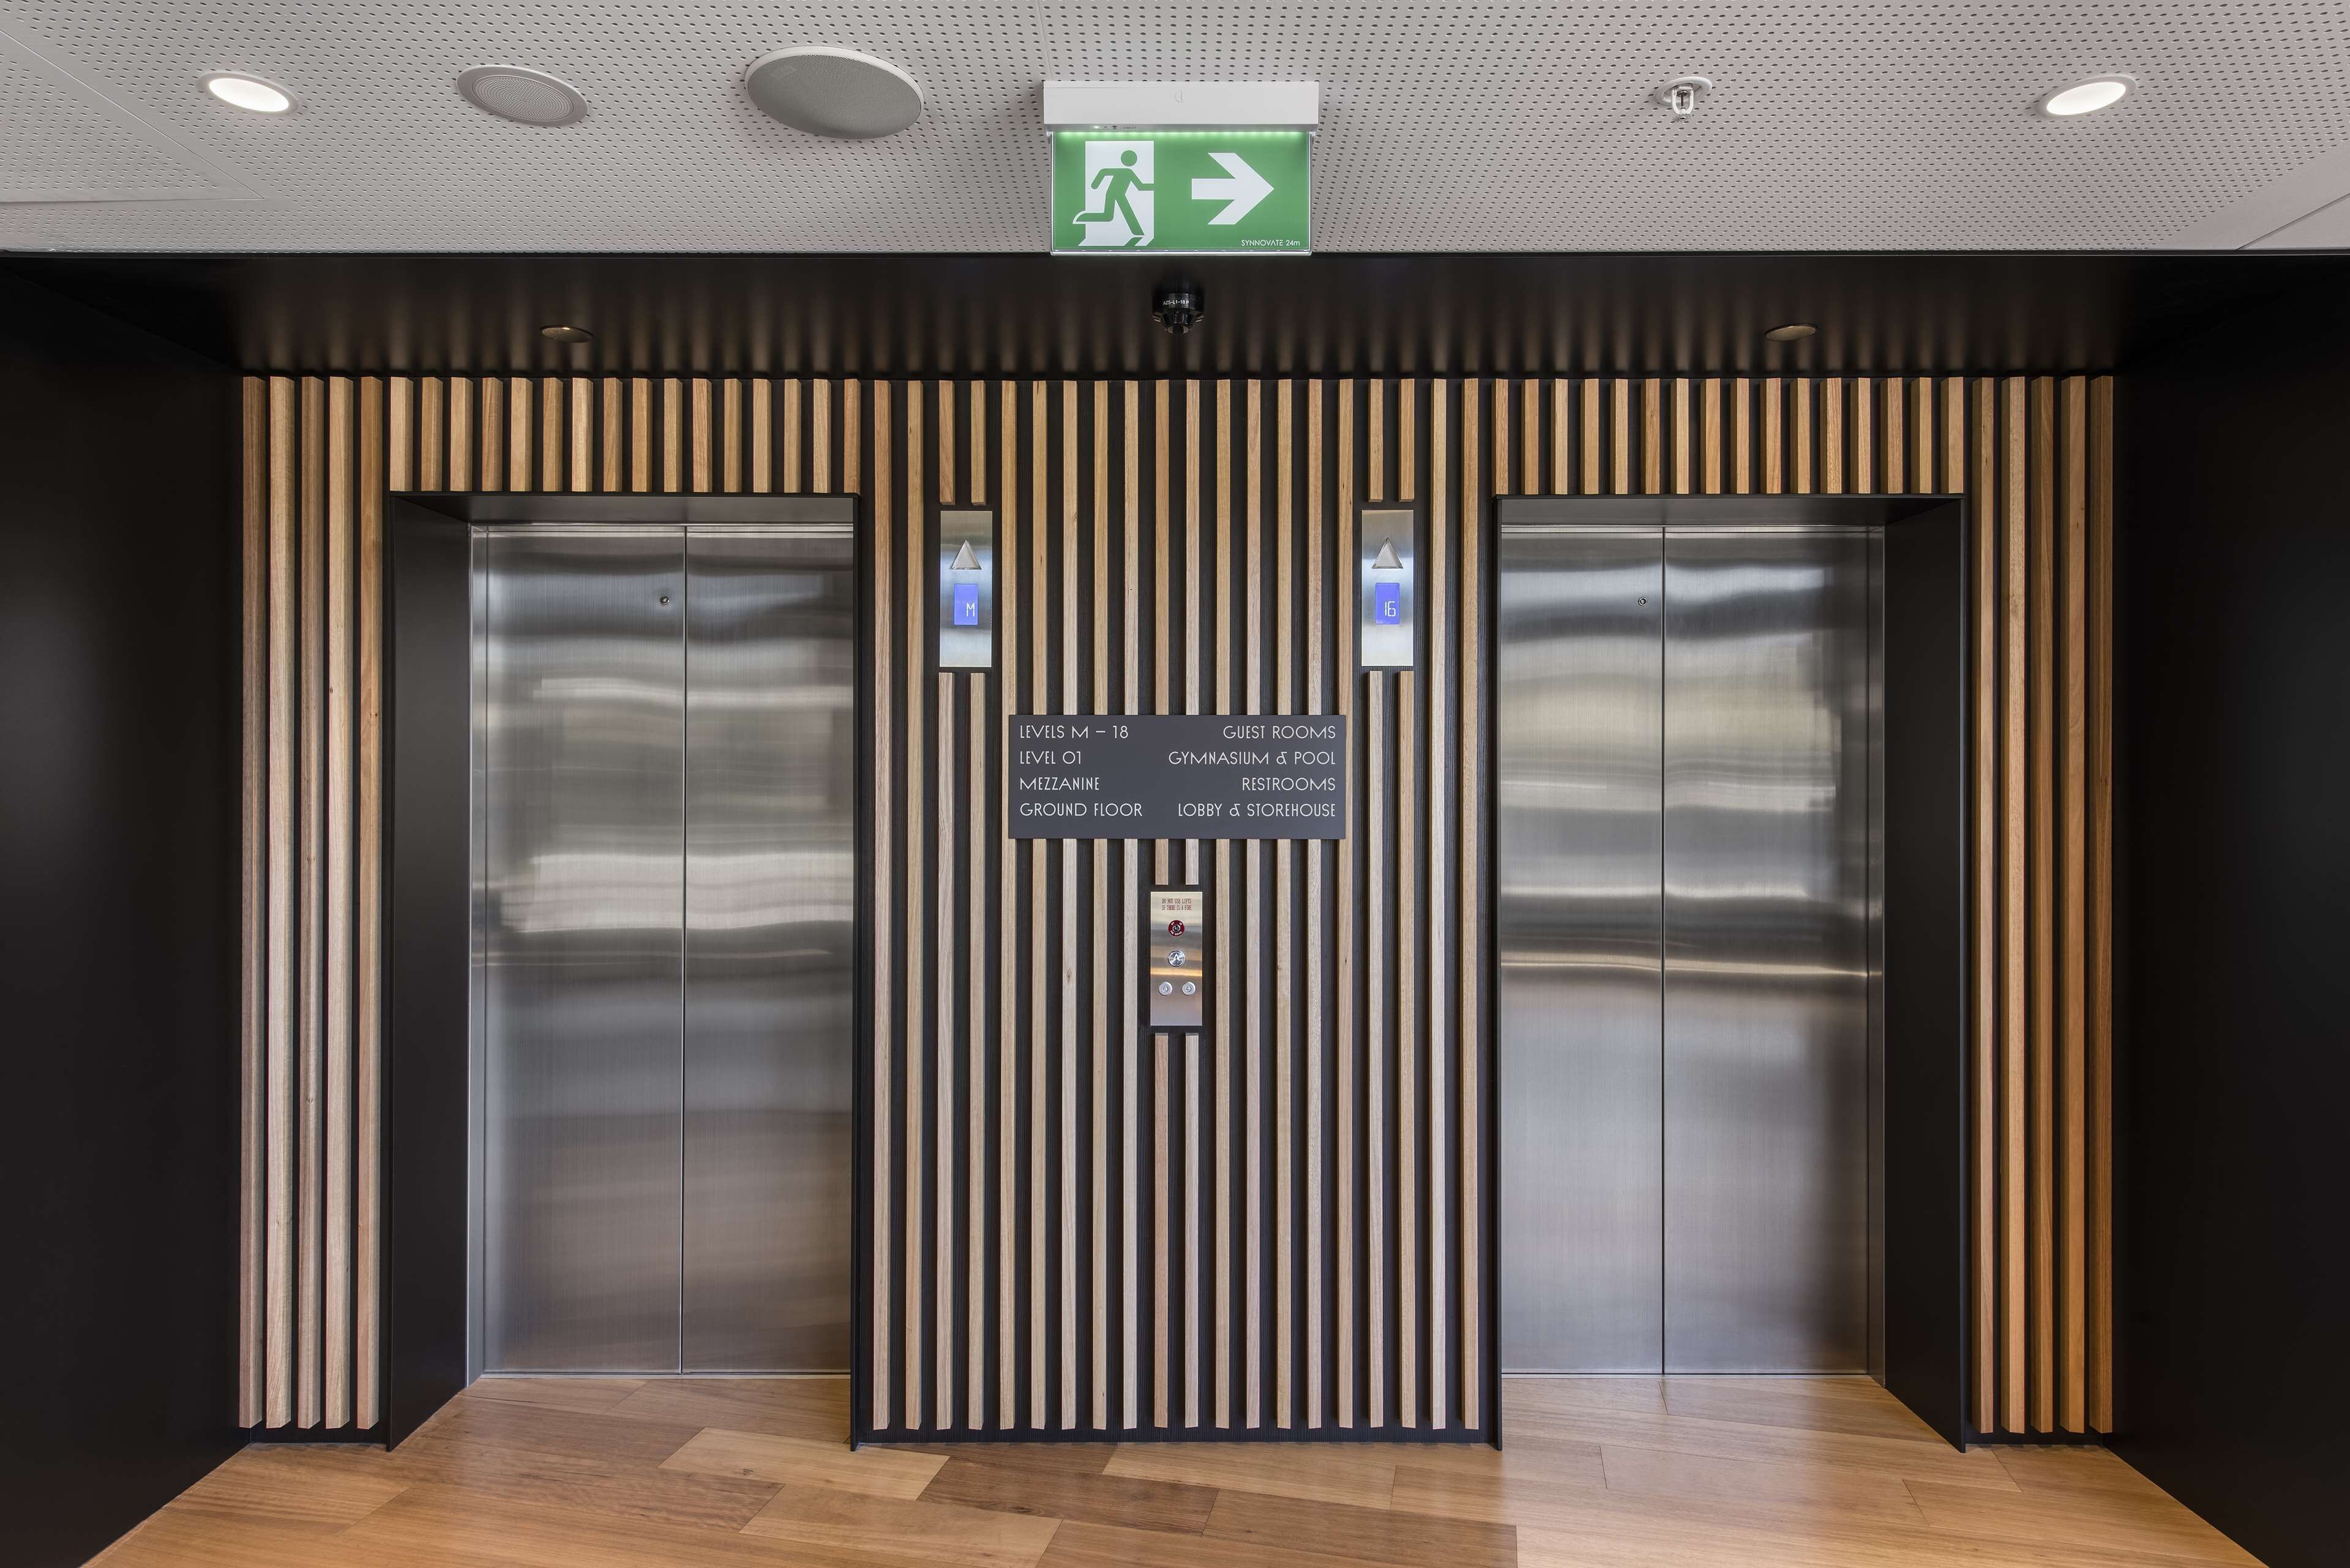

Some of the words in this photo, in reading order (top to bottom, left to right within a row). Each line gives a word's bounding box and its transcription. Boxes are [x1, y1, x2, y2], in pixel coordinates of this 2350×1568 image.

[966, 602, 975, 618] M
[1385, 601, 1396, 617] 16
[1020, 725, 1065, 739] LEVELS
[1072, 725, 1088, 739] M
[1112, 725, 1129, 739] 18
[1223, 725, 1265, 739] GUEST
[1273, 725, 1336, 739] ROOMS
[1020, 750, 1056, 764] LEVEL
[1169, 751, 1269, 765] GYMNASIUM
[1276, 751, 1288, 765] &
[1294, 751, 1336, 765] POOL
[1020, 777, 1099, 791] MEZZANINE
[1242, 777, 1336, 791] RESTROOMS
[1020, 802, 1087, 816] GROUND
[1094, 802, 1143, 816] FLOOR
[1178, 803, 1222, 817] LOBBY
[1229, 803, 1241, 817] &
[1247, 803, 1336, 817] STOREHOUSE
